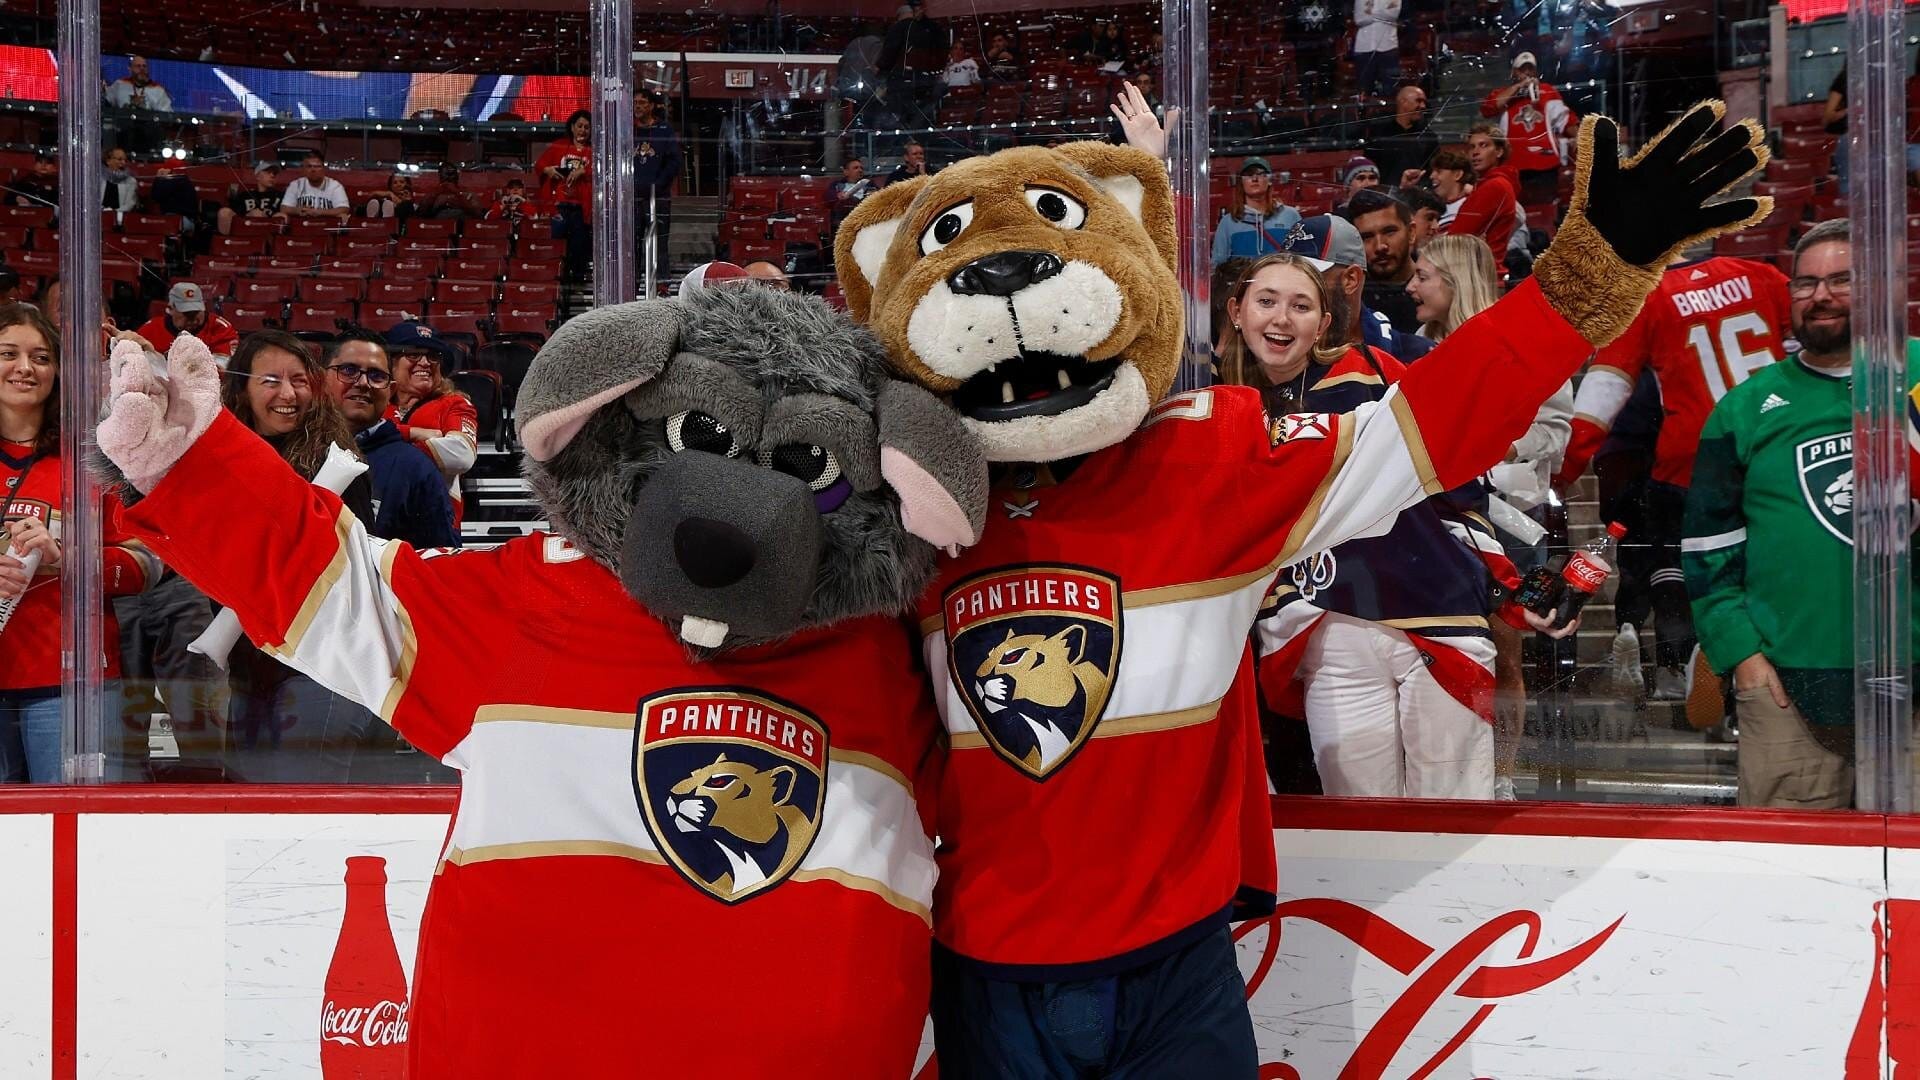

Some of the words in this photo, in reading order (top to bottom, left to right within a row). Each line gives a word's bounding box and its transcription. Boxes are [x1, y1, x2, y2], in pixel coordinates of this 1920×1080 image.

[730, 71, 749, 86] EXIT
[1671, 275, 1753, 317] BARKOV
[1686, 310, 1777, 401] 16
[954, 579, 1100, 624] PANTHERS
[659, 703, 815, 757] PANTHERS
[321, 1000, 409, 1048] Coca-Cola
